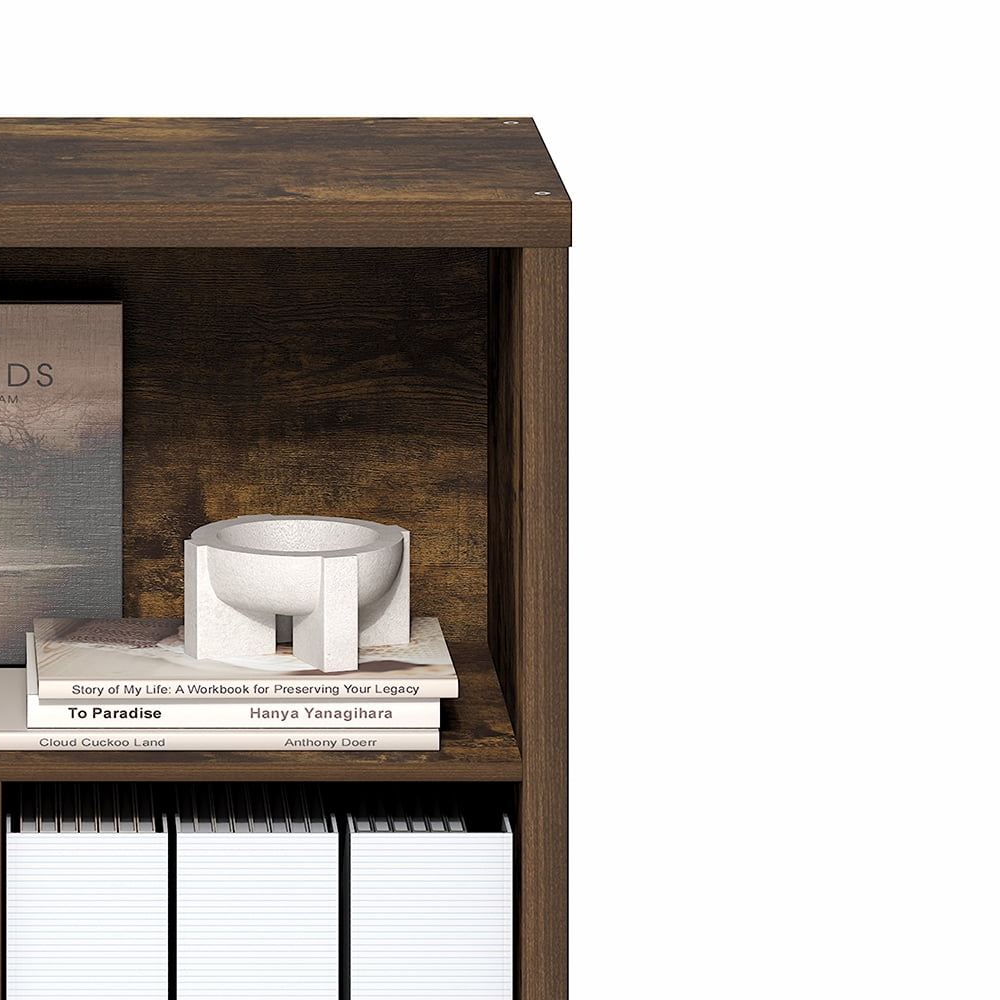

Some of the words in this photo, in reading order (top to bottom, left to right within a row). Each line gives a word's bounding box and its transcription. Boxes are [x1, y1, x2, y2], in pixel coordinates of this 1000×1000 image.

[72, 684, 104, 697] Story
[108, 684, 120, 695] of
[124, 684, 142, 697] My
[146, 684, 172, 695] Life:
[175, 684, 184, 695] A
[187, 684, 250, 695] Workbook
[253, 684, 270, 694] for
[274, 684, 340, 696] Preserving
[343, 684, 372, 694] Your
[375, 684, 420, 696] Legacy
[68, 707, 87, 719] To
[92, 707, 162, 719] Paradise
[250, 707, 299, 722] Hanya
[304, 707, 393, 722] Yanagihara
[39, 738, 77, 747] Cloud
[81, 738, 130, 747] Cuckoo
[134, 738, 166, 747] Land
[284, 738, 338, 748] Anthony
[342, 738, 377, 747] Doerr
